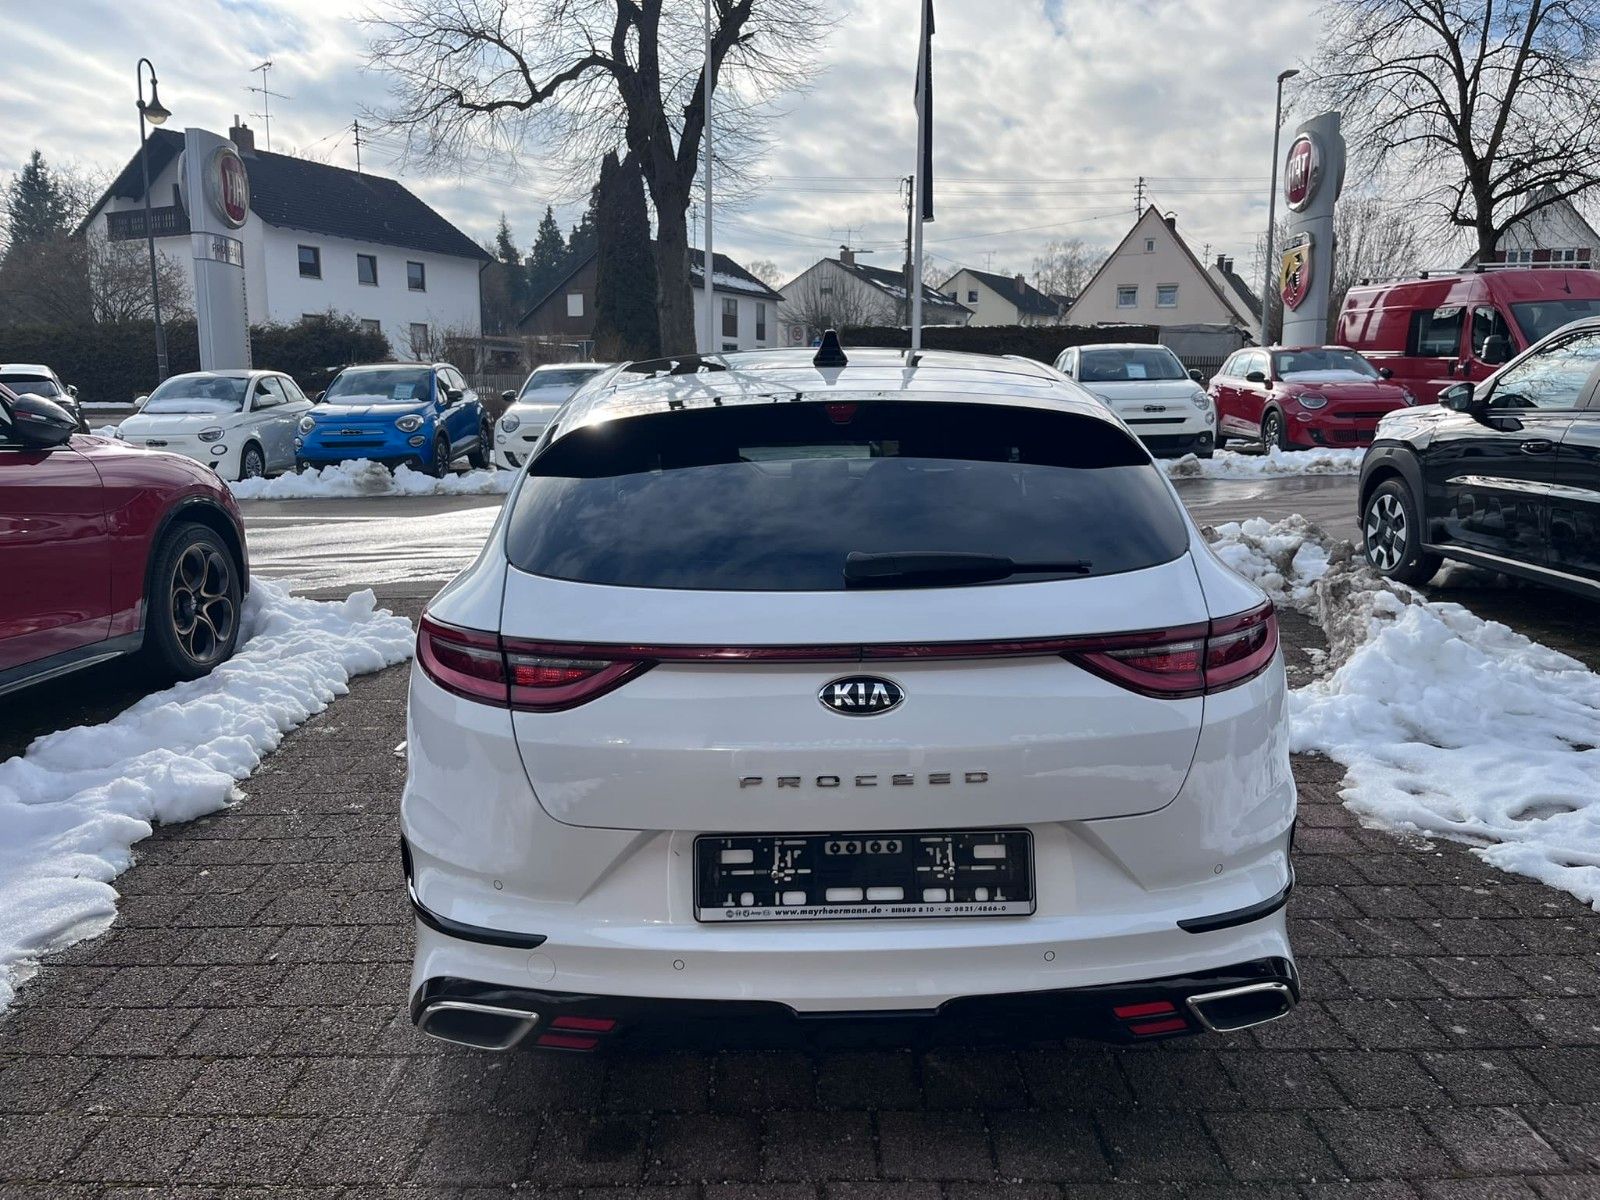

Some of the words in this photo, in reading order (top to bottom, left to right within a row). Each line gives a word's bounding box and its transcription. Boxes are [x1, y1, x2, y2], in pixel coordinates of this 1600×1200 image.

[1289, 153, 1309, 192] FIAT
[833, 683, 892, 706] KIA
[738, 771, 989, 789] PROCEED
[774, 905, 882, 917] www.mayrhoermann.de
